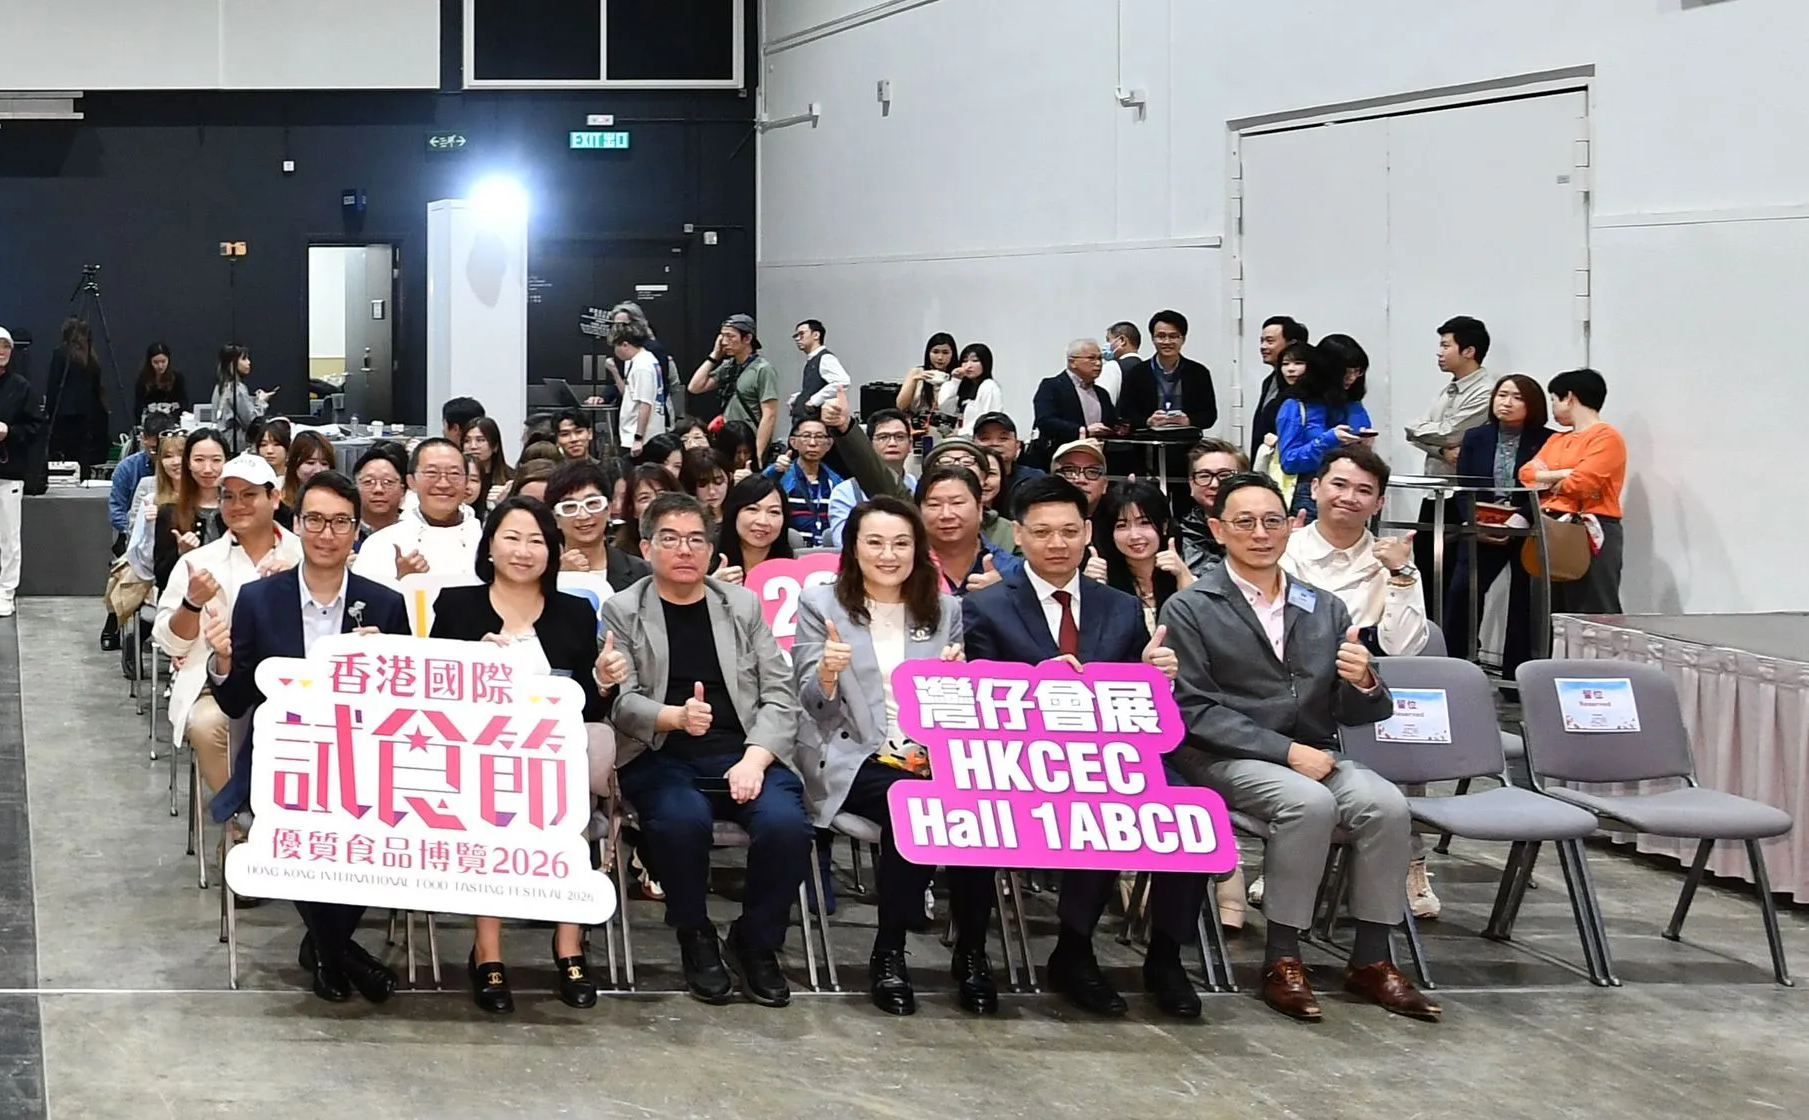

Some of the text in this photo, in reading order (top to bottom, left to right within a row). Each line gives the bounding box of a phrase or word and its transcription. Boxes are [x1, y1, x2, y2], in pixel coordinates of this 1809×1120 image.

[571, 132, 602, 148] EXIT
[329, 651, 513, 705] 香港國際
[912, 675, 1163, 734] 灣仔會展
[273, 703, 568, 832] 試食節
[947, 738, 1146, 795] HKCEC
[907, 797, 1218, 854] Hall 1ABCD
[271, 828, 570, 879] 優質食品博覽2026
[247, 864, 278, 877] HONG
[284, 867, 316, 880] KONG
[320, 871, 409, 888] INTERNATIONAL
[416, 878, 448, 890] FOOD
[455, 882, 504, 895] TASTING
[508, 885, 562, 900] FESTIVAL
